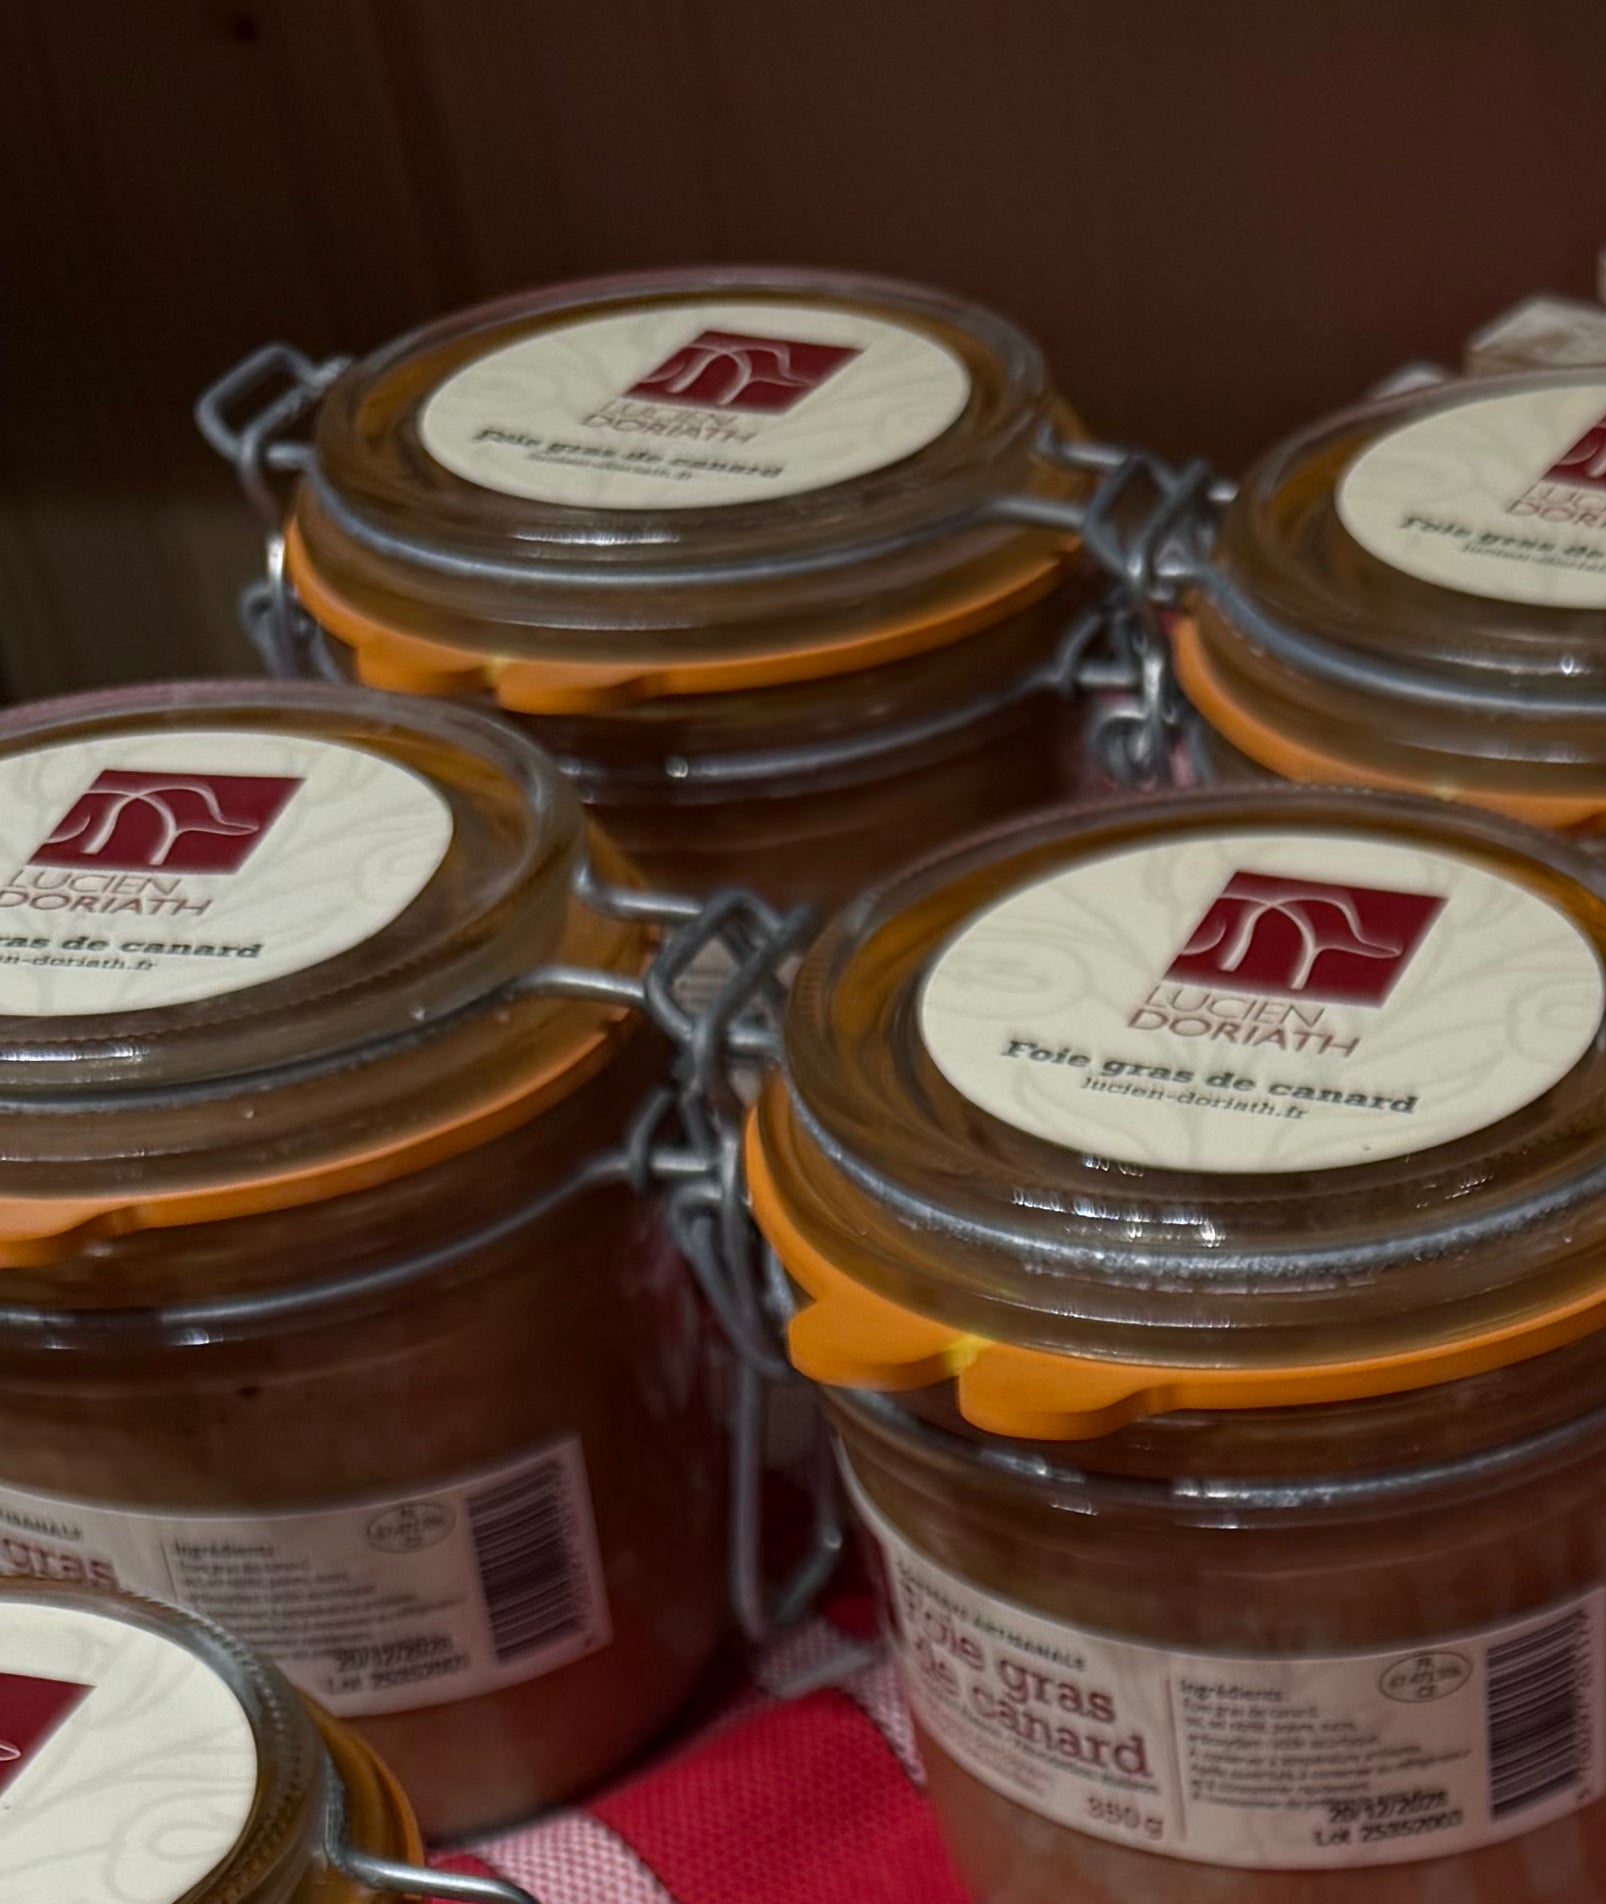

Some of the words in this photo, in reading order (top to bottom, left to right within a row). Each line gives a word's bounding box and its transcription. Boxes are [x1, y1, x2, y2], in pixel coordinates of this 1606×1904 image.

[581, 412, 758, 445] DORIATH
[6, 869, 183, 897] LUCIEN
[61, 934, 113, 953] de
[121, 940, 264, 961] canard
[1143, 984, 1326, 1028] LUCIEN
[1126, 1007, 1362, 1059] DORIATH
[1002, 1038, 1092, 1069] Foie
[1101, 1056, 1194, 1085] gras
[1206, 1070, 1256, 1093] de
[1269, 1079, 1421, 1116] canard
[1080, 1075, 1309, 1121] lucien-doriath.fr
[998, 1658, 1117, 1724] gras
[970, 1685, 1153, 1778] canard
